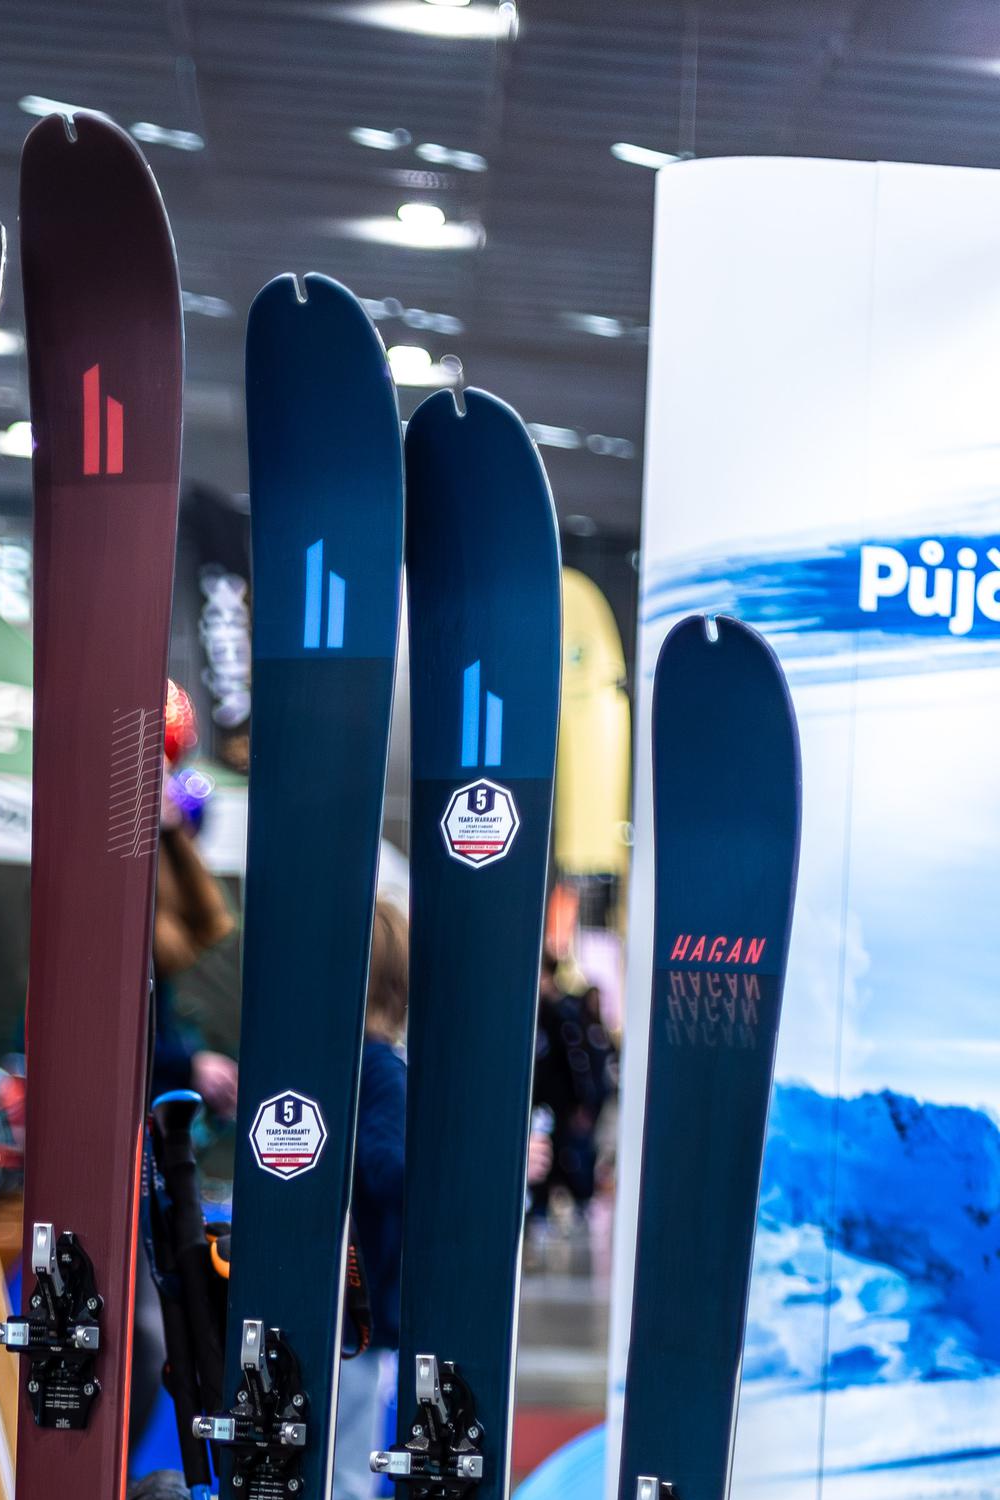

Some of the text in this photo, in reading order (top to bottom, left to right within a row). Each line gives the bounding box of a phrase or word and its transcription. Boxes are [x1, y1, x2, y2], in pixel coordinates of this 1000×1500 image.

[476, 789, 487, 811] 5
[670, 934, 766, 964] HAGAN
[283, 1100, 294, 1123] 5
[266, 1128, 311, 1136] YEARS WARRANTY
